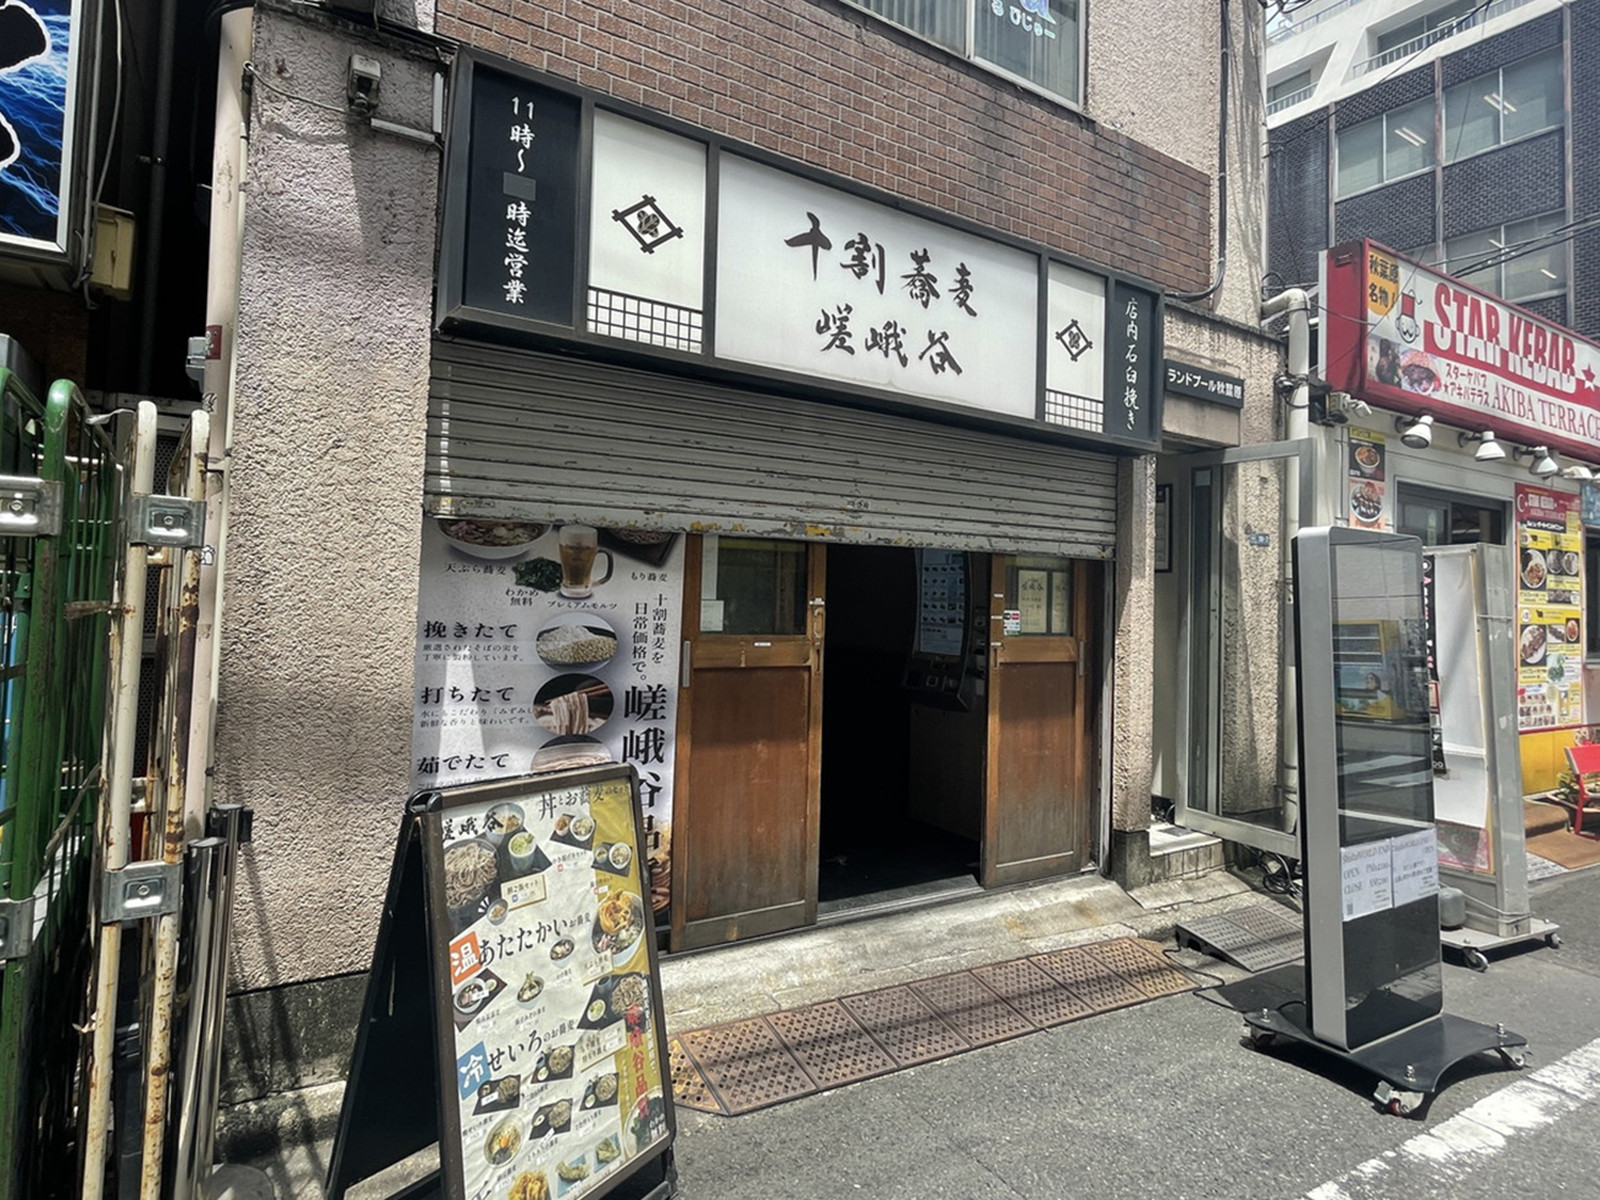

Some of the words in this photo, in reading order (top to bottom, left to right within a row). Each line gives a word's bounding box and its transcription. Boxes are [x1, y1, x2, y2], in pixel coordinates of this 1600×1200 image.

[784, 212, 977, 317] 十割蕎麦
[1370, 254, 1398, 284] 秋葉原
[815, 303, 963, 375] 嵯峨谷
[1435, 282, 1500, 367] STAR
[1492, 383, 1536, 423] AKIBA
[423, 620, 518, 639] 挽きたて
[420, 686, 515, 704] 打ちたて
[416, 753, 510, 775] 茹でたて
[450, 942, 479, 977] 温
